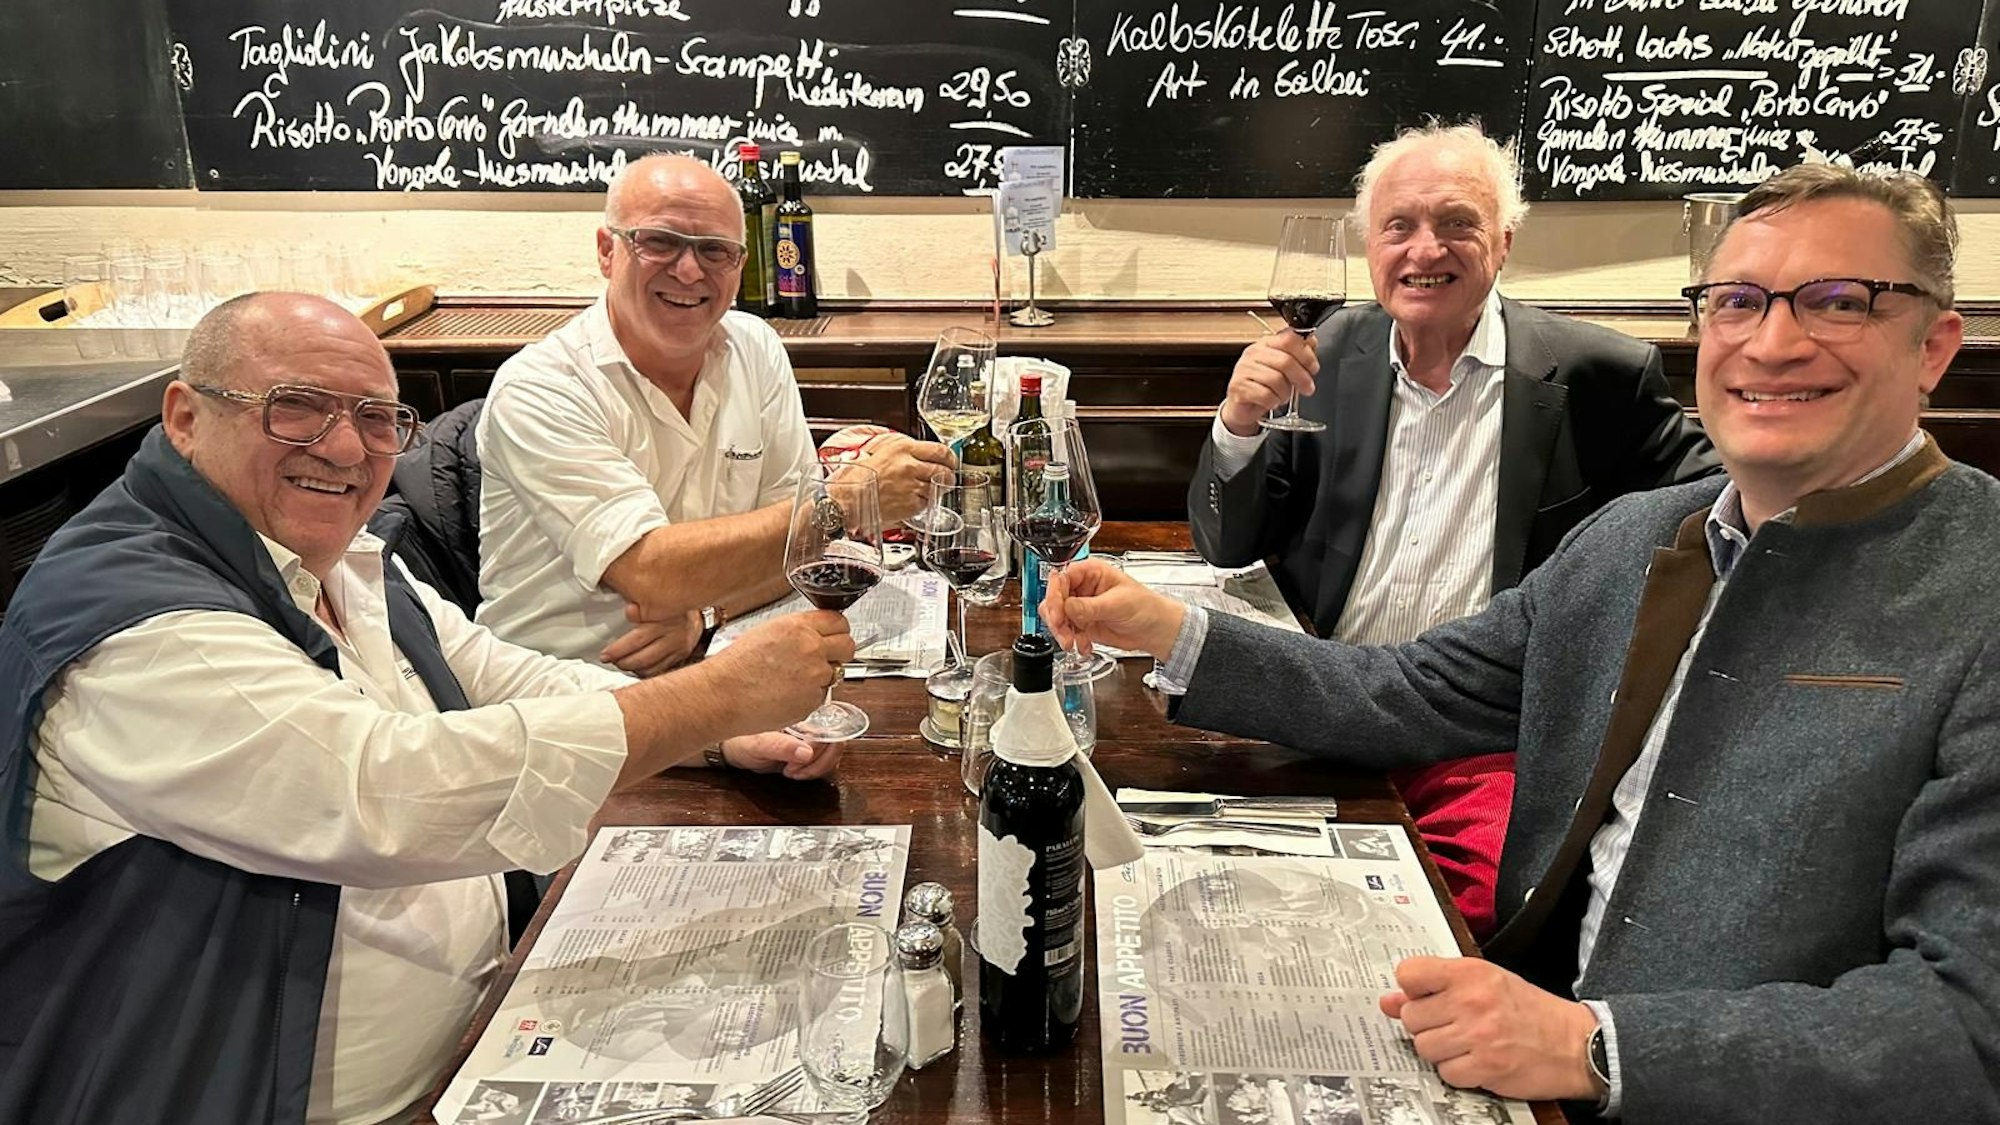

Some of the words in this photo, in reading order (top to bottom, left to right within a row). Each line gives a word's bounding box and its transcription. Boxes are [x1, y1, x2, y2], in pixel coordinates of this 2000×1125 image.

[229, 19, 375, 98] Tagliolini
[1147, 60, 1207, 107] Art
[1230, 66, 1260, 99] in
[1274, 53, 1370, 97] Salbei
[233, 91, 350, 150] Risotto
[1540, 76, 1634, 121] Risotto
[856, 871, 889, 919] BUON
[1111, 894, 1147, 989] APPETITO
[1122, 992, 1152, 1056] BUON
